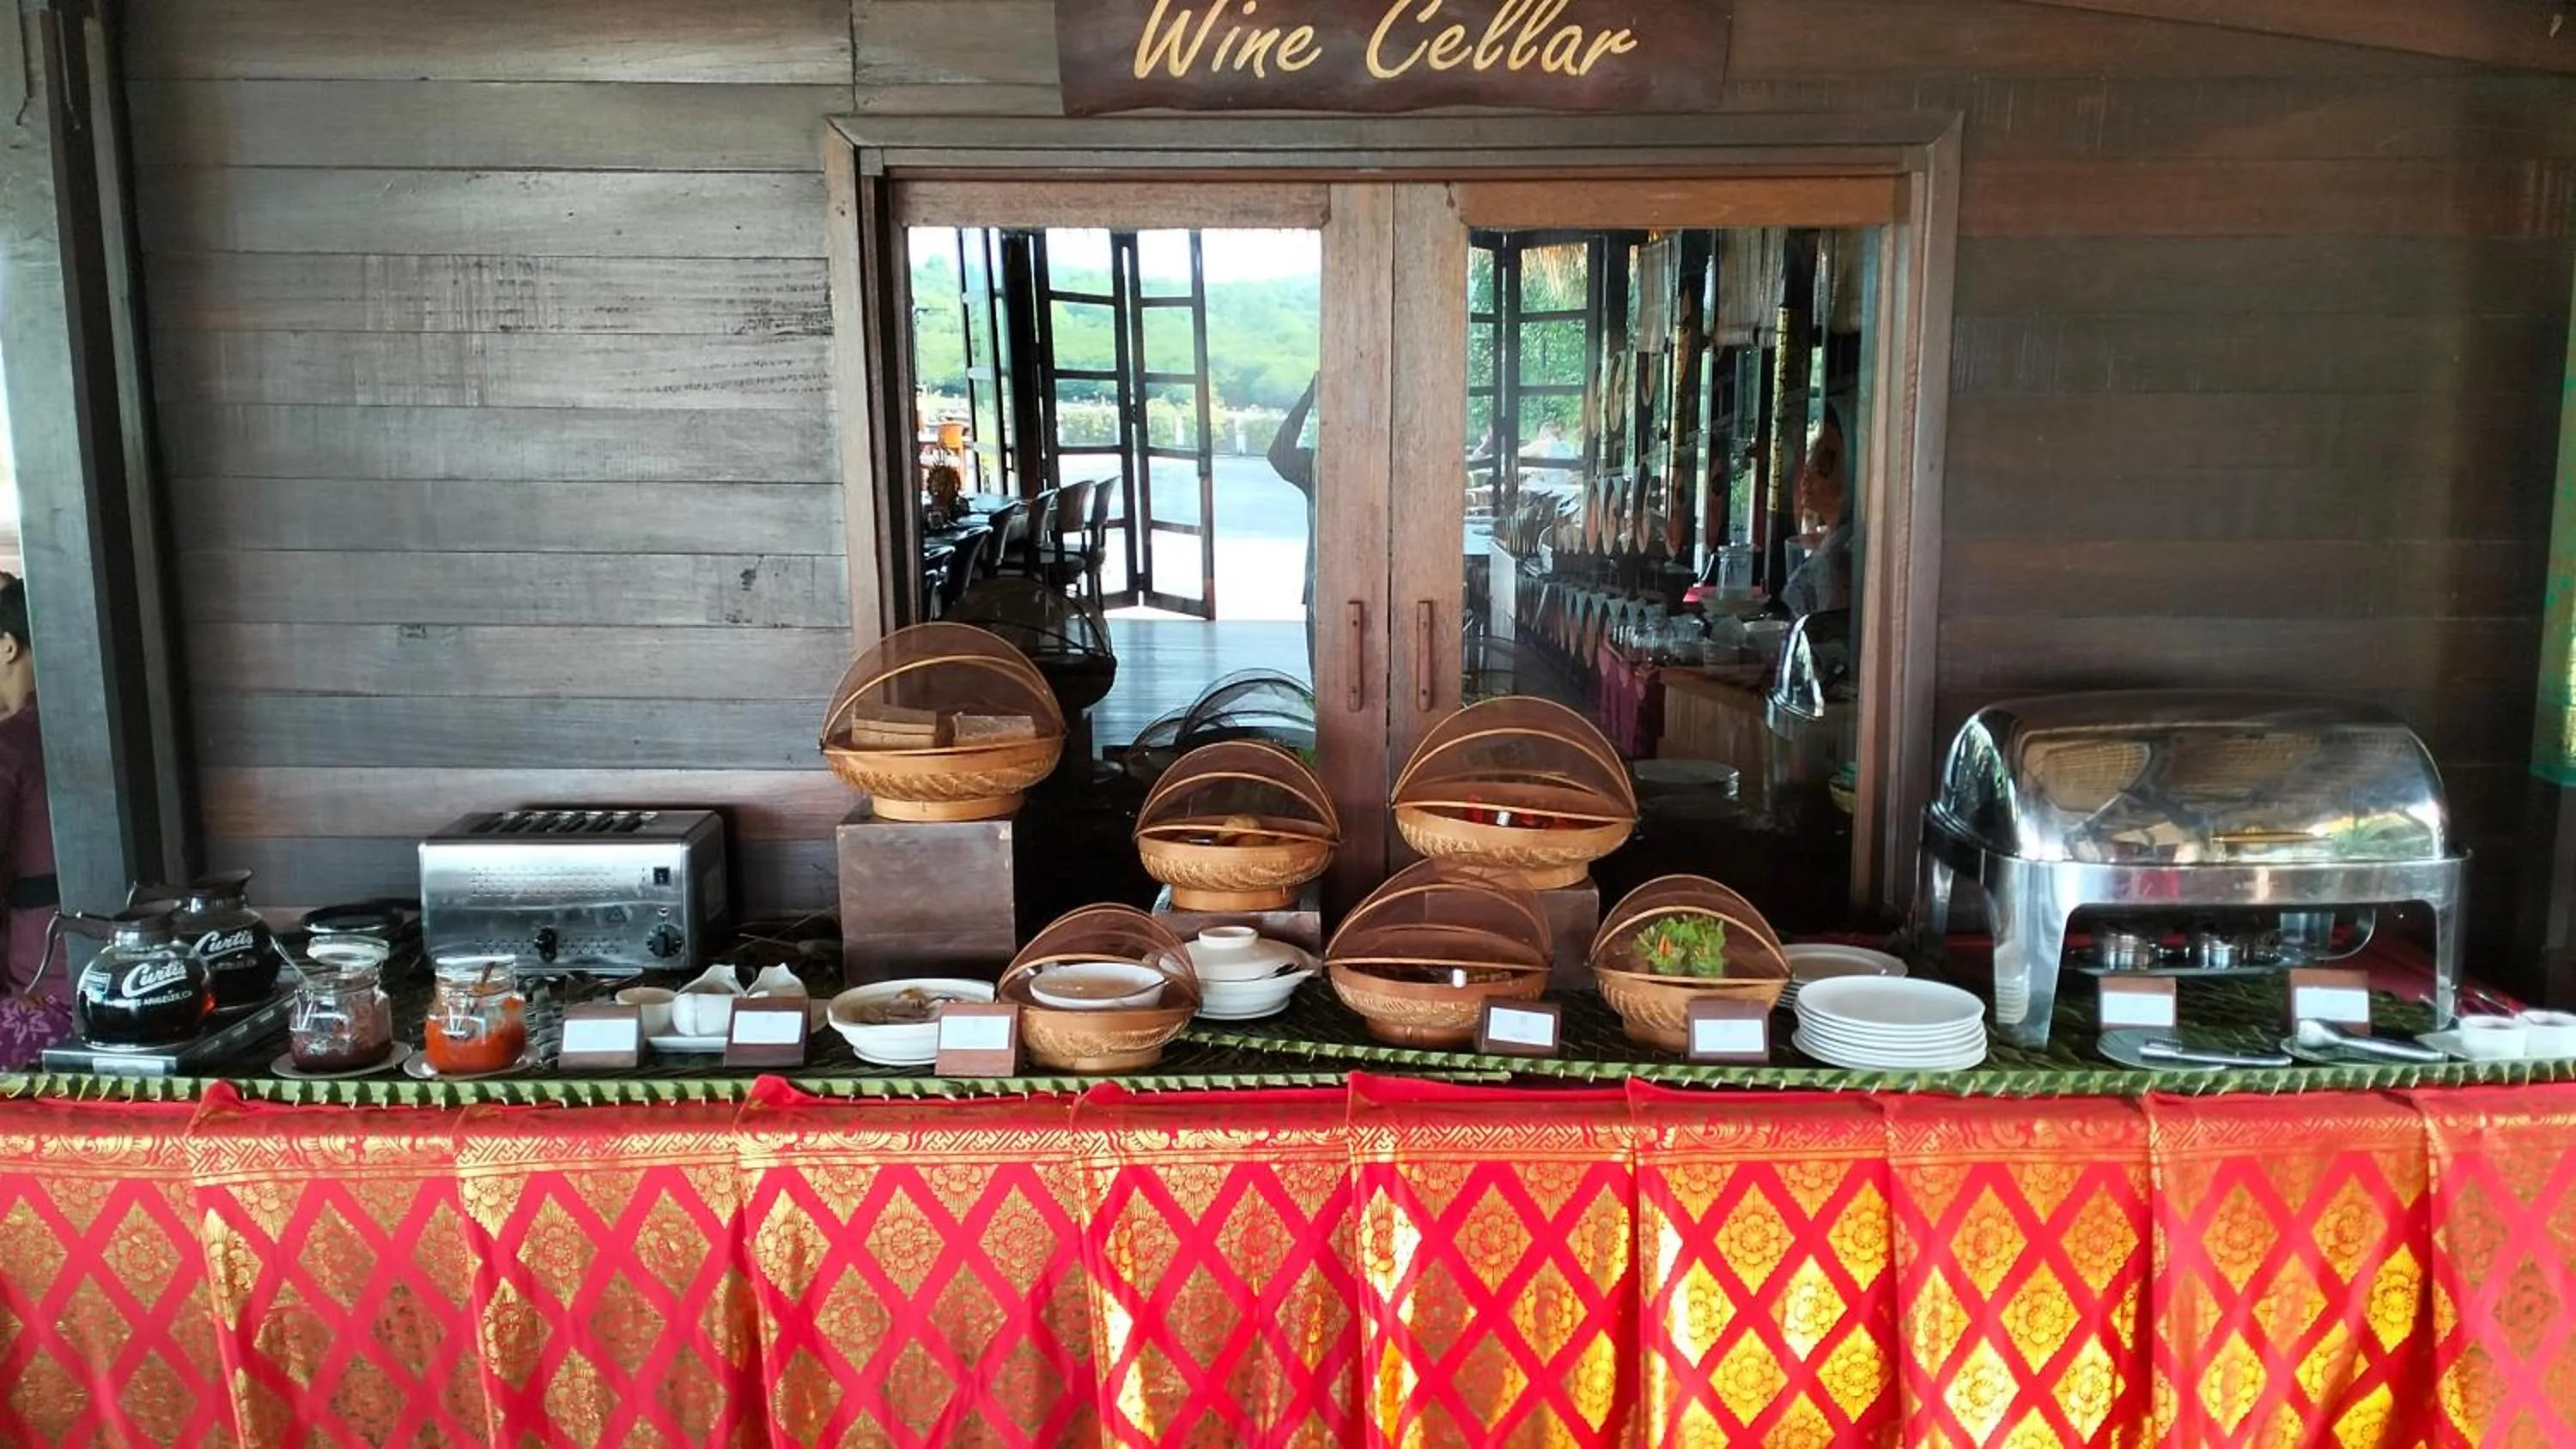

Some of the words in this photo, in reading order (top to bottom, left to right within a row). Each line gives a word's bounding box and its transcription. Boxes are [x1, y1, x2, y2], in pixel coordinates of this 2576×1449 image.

[1132, 0, 1322, 78] Wine
[1365, 0, 1637, 79] Cellar
[189, 930, 253, 961] Curtis
[121, 961, 186, 998] Curtis
